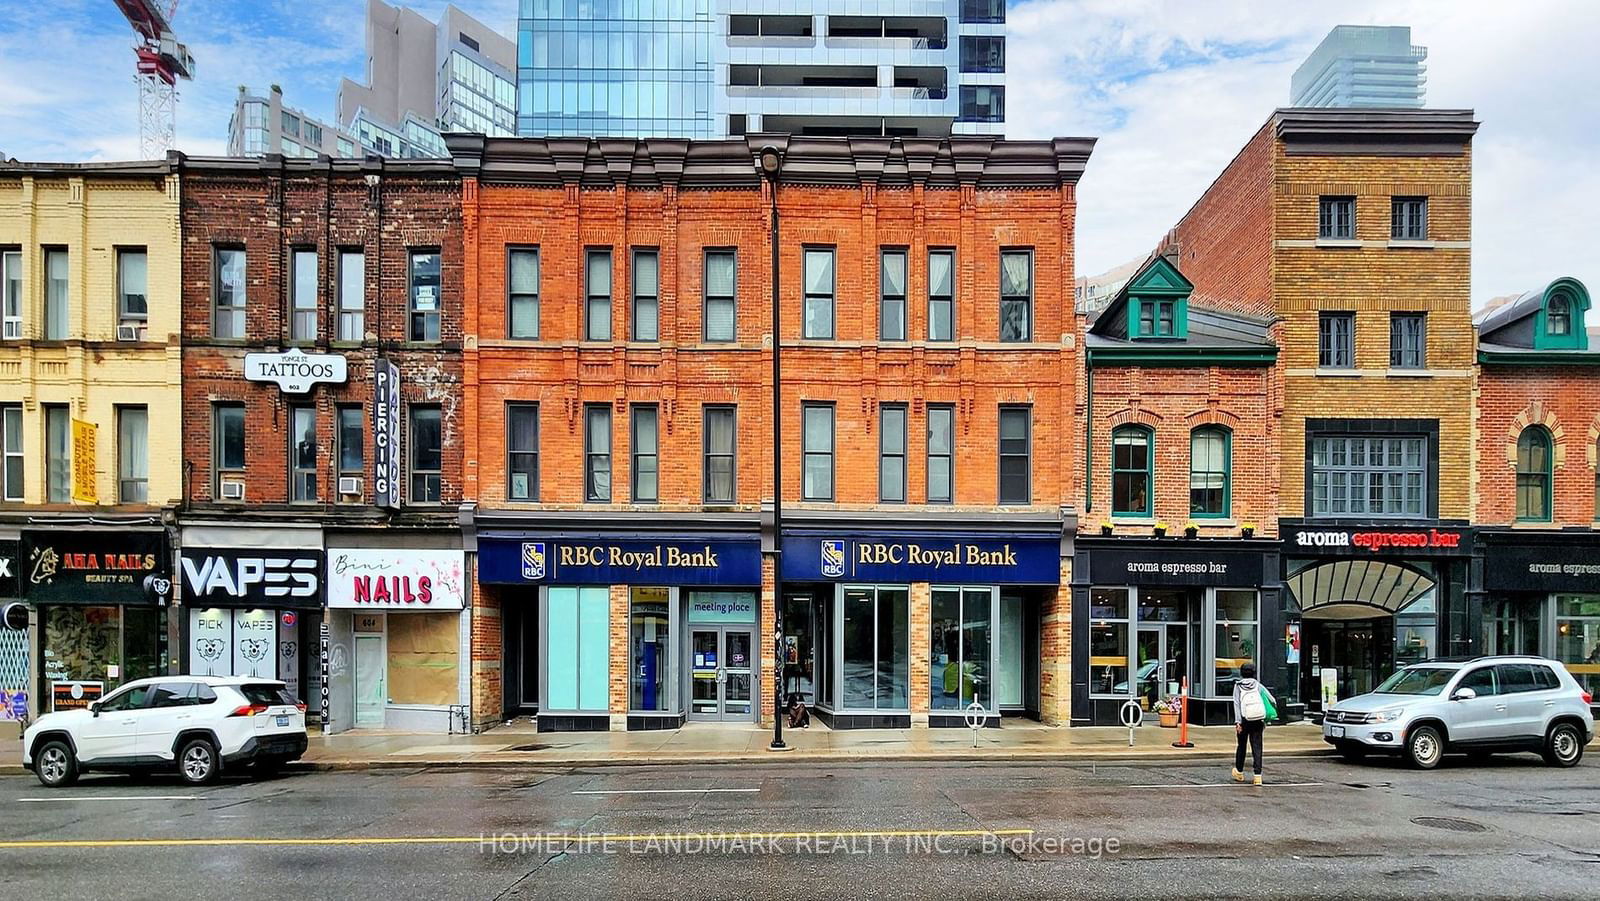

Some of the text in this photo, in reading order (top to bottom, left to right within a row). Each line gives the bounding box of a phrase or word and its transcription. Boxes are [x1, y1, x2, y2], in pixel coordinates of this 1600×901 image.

[258, 363, 333, 378] TATTOOS
[376, 372, 388, 494] PIERCING
[1296, 528, 1461, 551] aroma espresso bar
[105, 554, 156, 570] NAILS
[560, 545, 718, 570] RBC Royal Bank
[859, 544, 1018, 568] RBC Royal Bank
[335, 554, 391, 574] Bini
[824, 565, 842, 574] RBC
[1128, 562, 1227, 576] aroma espresso bar
[1529, 564, 1562, 572] aroma
[86, 575, 134, 583] BEAUTY SPA
[181, 556, 318, 597] VAPES
[524, 568, 542, 576] RBC
[354, 575, 432, 604] NAILS
[694, 602, 750, 614] meeting place
[198, 620, 273, 630] PICK VAPES
